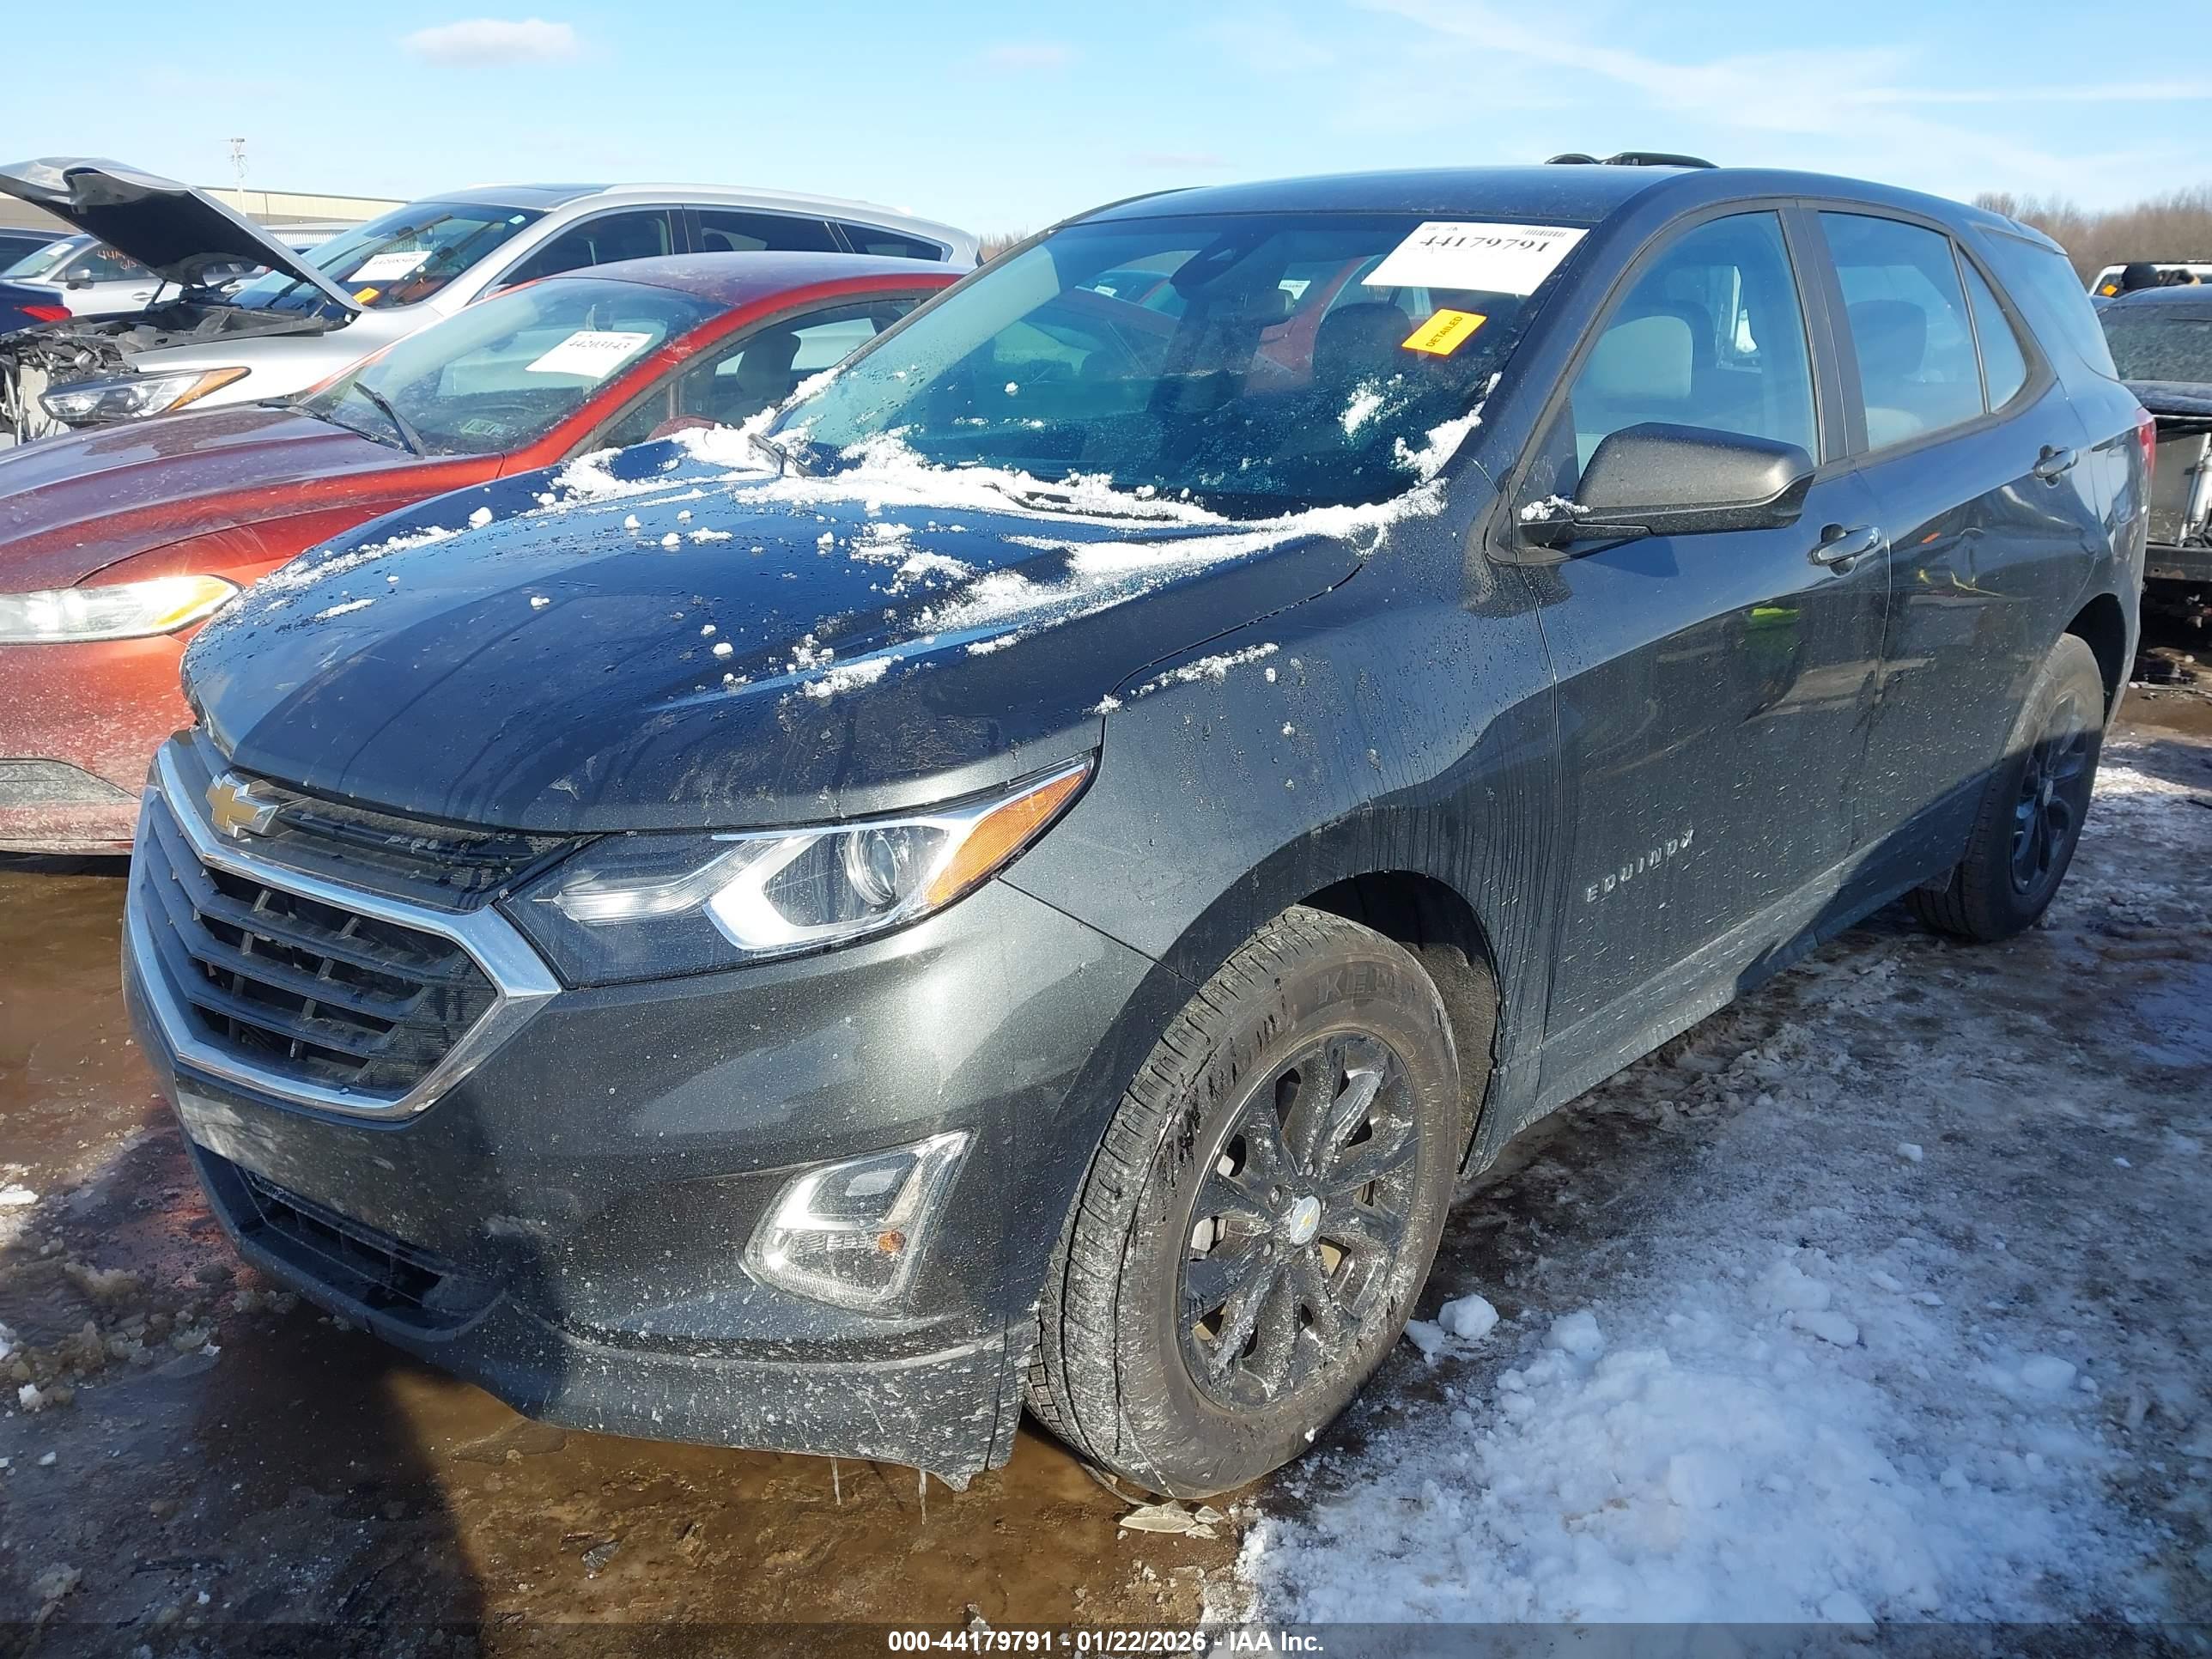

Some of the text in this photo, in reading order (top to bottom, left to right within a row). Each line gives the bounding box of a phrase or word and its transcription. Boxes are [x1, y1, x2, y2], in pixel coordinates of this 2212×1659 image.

[1419, 235, 1551, 253] 44179791
[1425, 315, 1463, 348] DETAILED
[1586, 829, 1695, 902] EQUINOX
